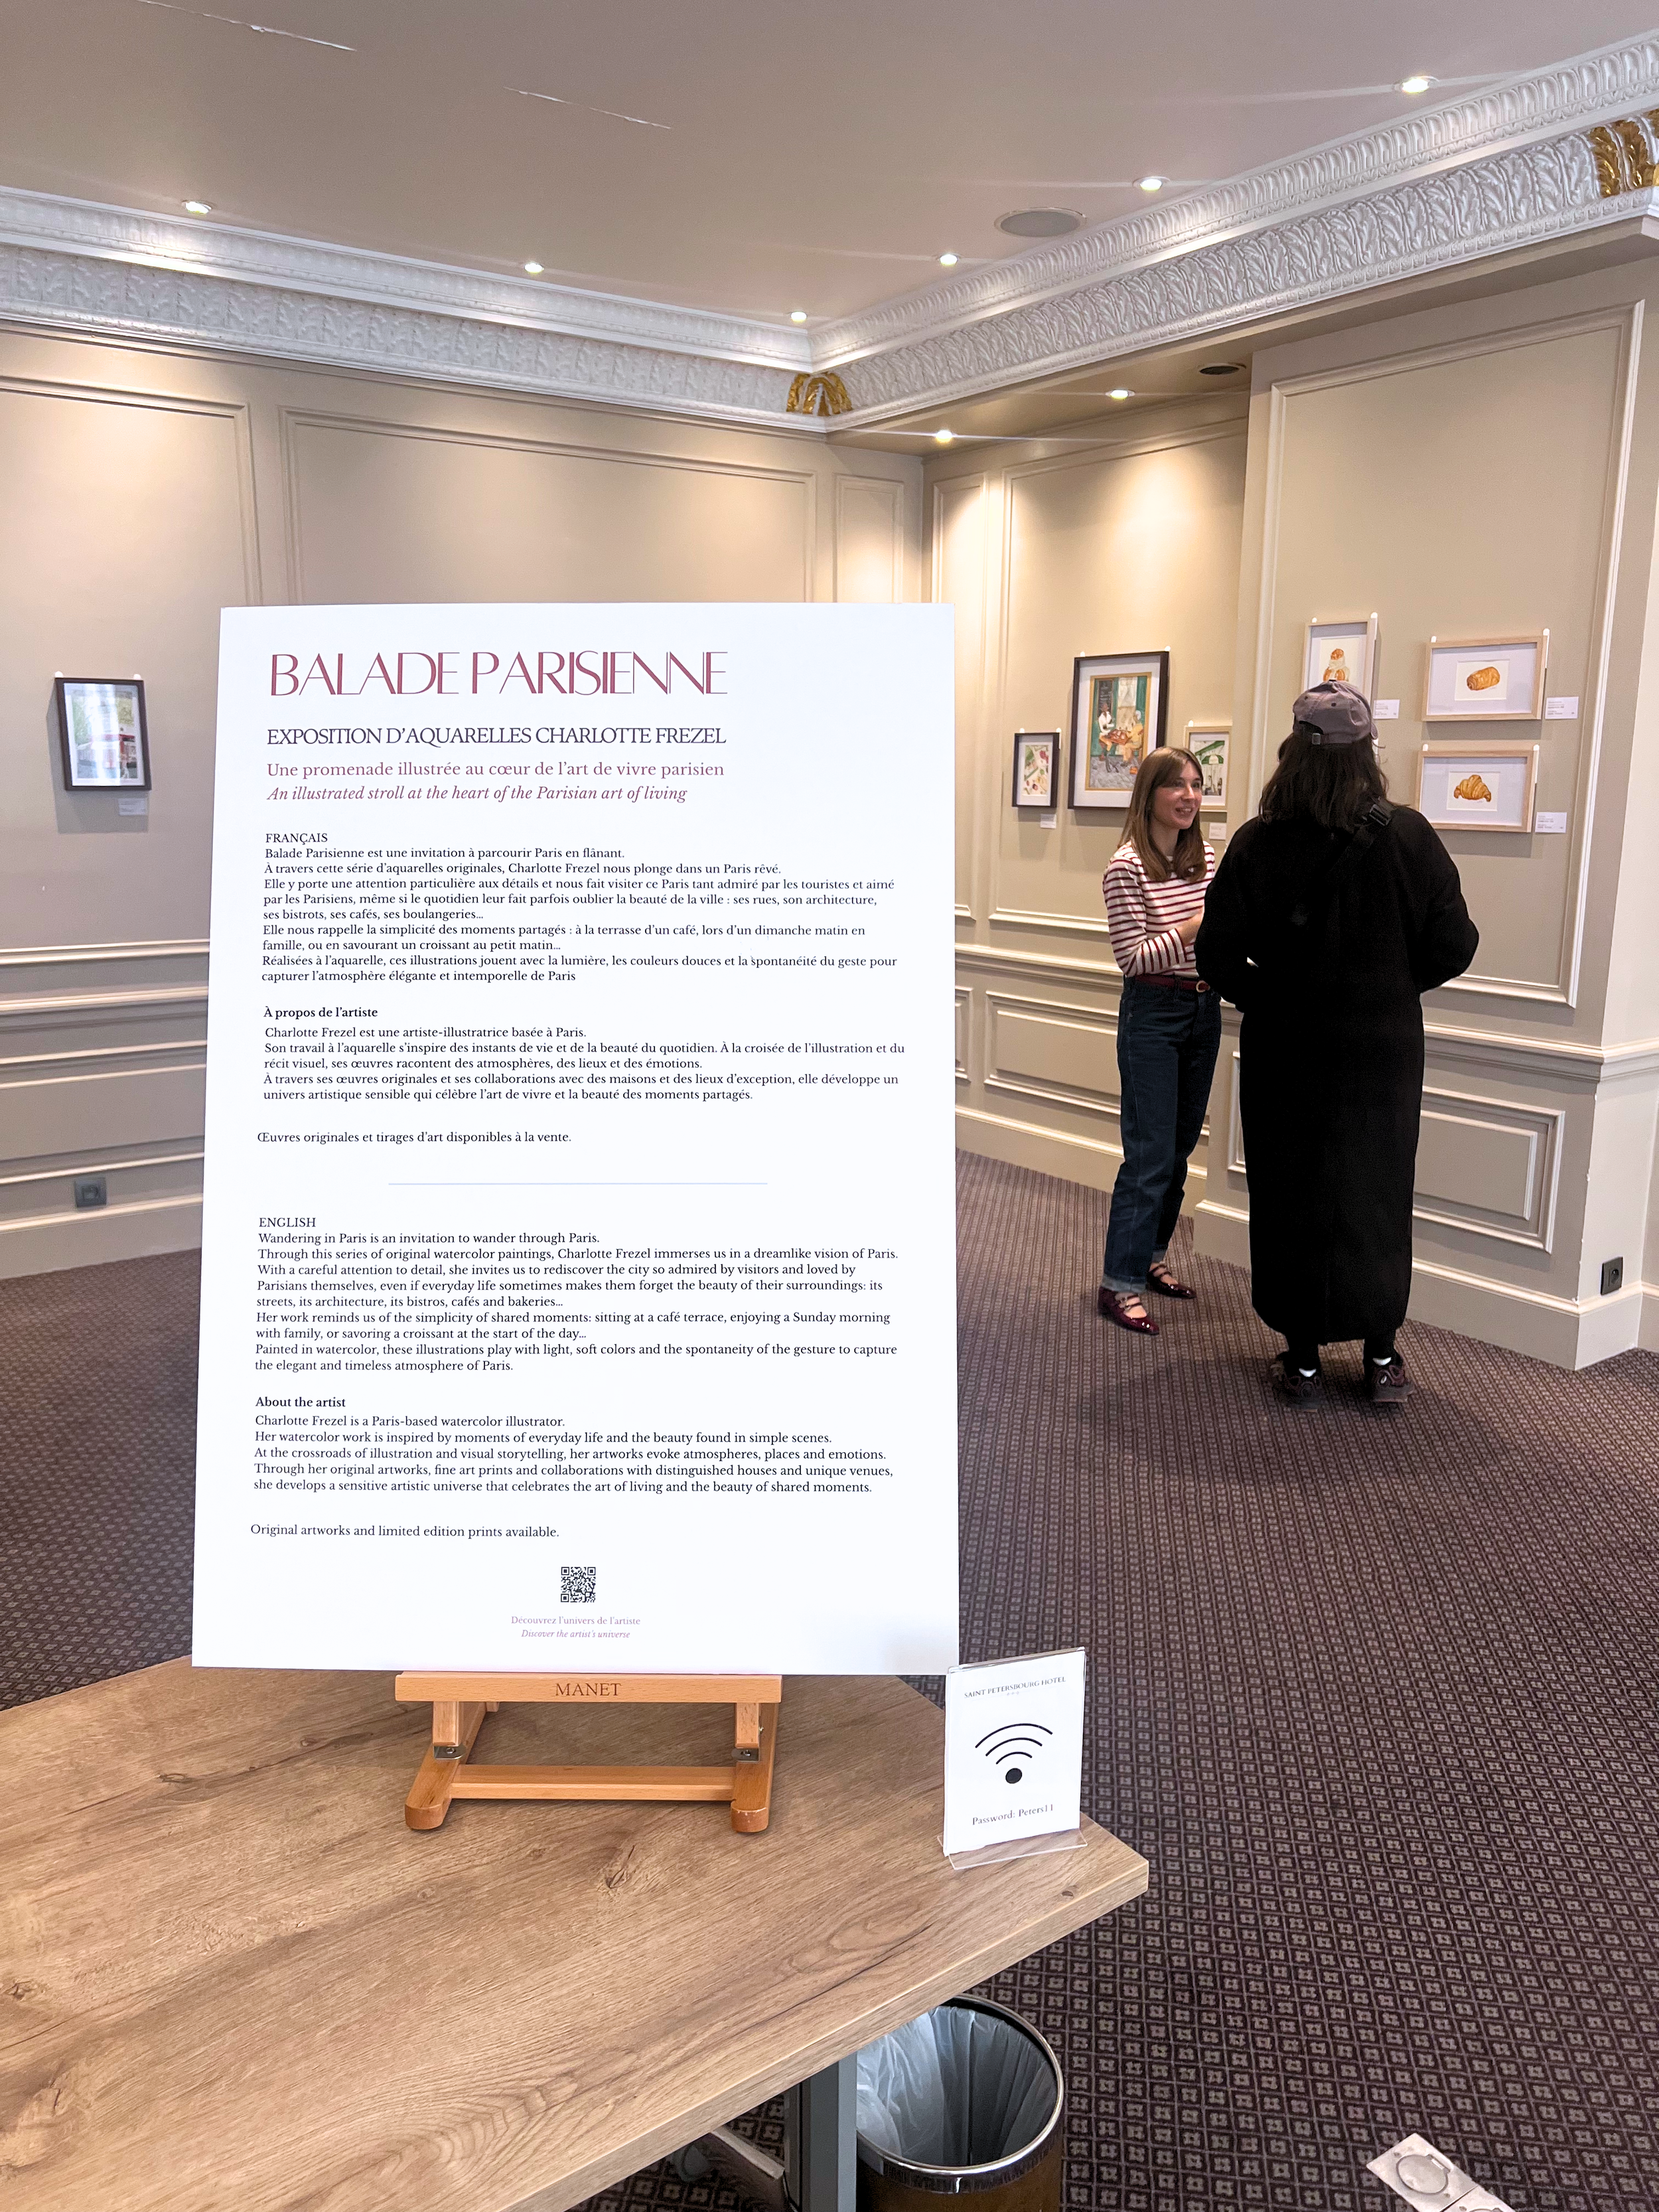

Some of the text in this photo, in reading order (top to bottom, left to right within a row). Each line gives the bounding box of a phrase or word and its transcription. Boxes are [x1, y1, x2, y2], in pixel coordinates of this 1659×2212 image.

[271, 650, 727, 696] BALADE PARISIENNE
[267, 728, 382, 745] EXPOSITION
[536, 727, 652, 743] CHARLOTTE
[656, 728, 727, 743] FREZEL
[267, 763, 298, 776] Une
[303, 762, 393, 779] promenade
[398, 762, 461, 774] illustrée
[465, 765, 484, 775] au
[489, 766, 530, 774] cœur
[534, 761, 554, 775] de
[593, 761, 613, 776] de
[616, 762, 656, 775] vivre
[661, 763, 724, 778] parisien
[266, 784, 688, 804] An illustrated stroll at the heart of the Parisian art of living
[265, 833, 328, 845] FRANÇAIS
[265, 848, 302, 858] Balade
[306, 848, 364, 857] Parisienne
[411, 848, 465, 857] invitation
[468, 847, 475, 857] à
[478, 848, 532, 860] parcourir
[535, 848, 562, 857] Paris
[583, 848, 624, 857] flânant.
[263, 861, 273, 874] À
[346, 863, 373, 873] série
[447, 863, 504, 875] originales,
[508, 863, 561, 873] Charlotte
[565, 863, 600, 873] Frezel
[634, 863, 672, 876] plonge
[676, 863, 701, 873] dans
[724, 864, 751, 873] Paris
[755, 864, 780, 873] rêvé.
[262, 973, 309, 983] capturer
[390, 970, 436, 983] élégante
[439, 972, 451, 981] et
[454, 970, 527, 983] intemporelle
[530, 970, 545, 981] de
[548, 971, 575, 980] Paris
[263, 1005, 273, 1017] À
[275, 1010, 315, 1019] propos
[318, 1007, 333, 1017] de
[265, 1027, 318, 1037] Charlotte
[322, 1027, 356, 1037] Frezel
[403, 1027, 508, 1037] artiste-illustratrice
[512, 1027, 543, 1037] basée
[546, 1027, 553, 1037] à
[556, 1027, 586, 1037] Paris.
[264, 1059, 289, 1068] récit
[292, 1058, 328, 1069] visuel,
[455, 1058, 473, 1068] des
[477, 1058, 553, 1070] atmosphères,
[557, 1058, 575, 1068] des
[579, 1058, 607, 1068] lieux
[610, 1060, 621, 1069] et
[624, 1058, 642, 1068] des
[646, 1059, 702, 1068] émotions.
[257, 1132, 300, 1142] Œuvres
[304, 1132, 359, 1145] originales
[362, 1134, 374, 1142] et
[376, 1132, 413, 1144] tirages
[447, 1132, 512, 1144] disponibles
[515, 1131, 522, 1142] à
[524, 1131, 535, 1142] la
[259, 1218, 316, 1227] ENGLISH
[258, 1232, 599, 1246] Wandering in Paris is an invitation to wander through Paris.
[257, 1298, 295, 1308] streets,
[299, 1296, 312, 1306] its
[315, 1296, 386, 1308] architecture,
[390, 1296, 403, 1306] its
[407, 1296, 447, 1308] bistros,
[452, 1296, 479, 1306] cafés
[483, 1296, 504, 1306] and
[255, 1359, 513, 1373] the elegant and timeless atmosphere of Paris.
[255, 1396, 346, 1407] About the artist
[255, 1415, 309, 1426] Charlotte
[313, 1416, 346, 1426] Frezel
[350, 1415, 360, 1426] is
[372, 1416, 437, 1426] Paris-based
[441, 1416, 503, 1426] watercolor
[506, 1416, 565, 1426] illustrator.
[251, 1524, 559, 1539] Original artworks and limited edition prints available.
[597, 1616, 608, 1625] de
[555, 1682, 622, 1696] MANET
[964, 1676, 1066, 1699] SAINT PETERSBOURG HOTEL
[972, 1804, 1053, 1826] Password: Peters11
